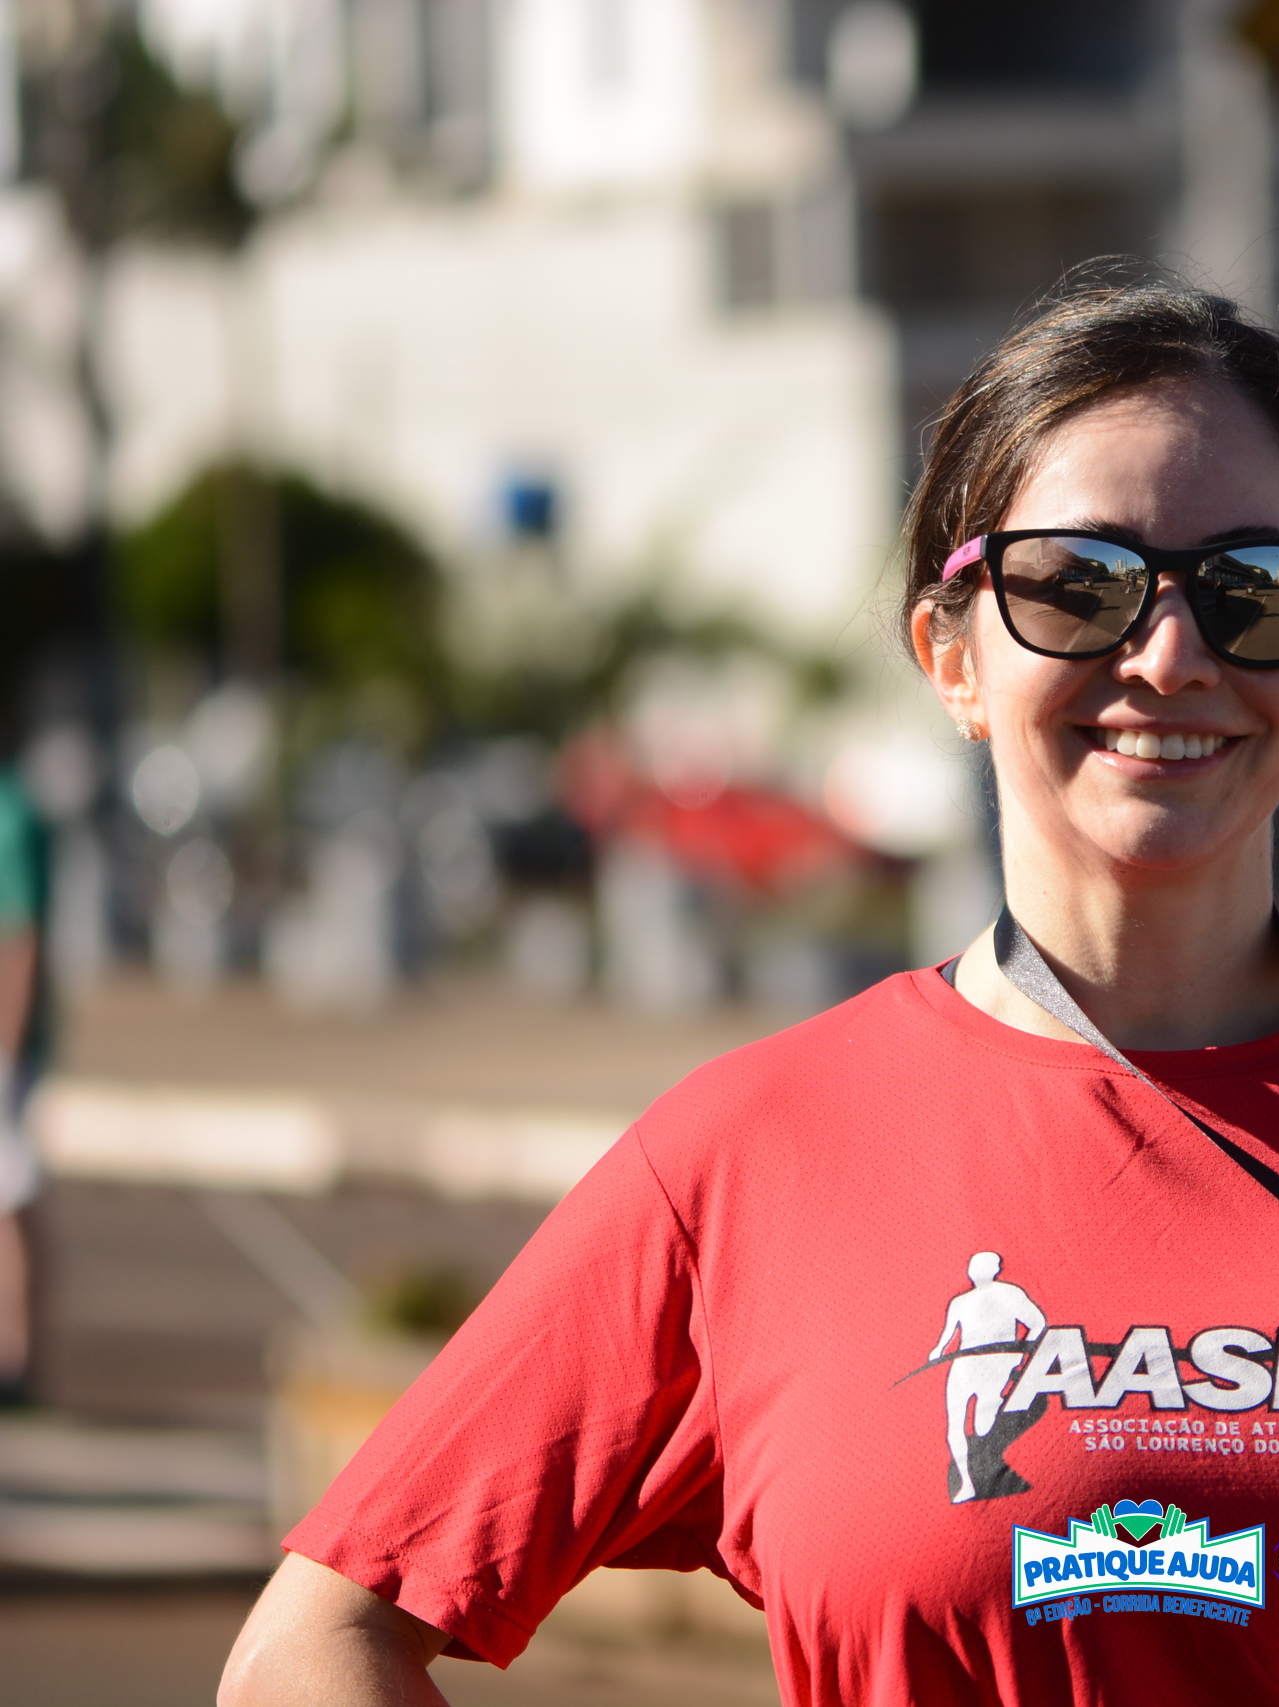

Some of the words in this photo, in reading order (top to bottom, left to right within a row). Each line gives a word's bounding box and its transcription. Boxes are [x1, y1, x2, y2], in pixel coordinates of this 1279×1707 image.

[1069, 1418, 1205, 1436] ASSOCIAÇÃO
[1215, 1421, 1240, 1436] DE
[1085, 1434, 1125, 1451] SÃO
[1136, 1436, 1244, 1456] LOURENÇO
